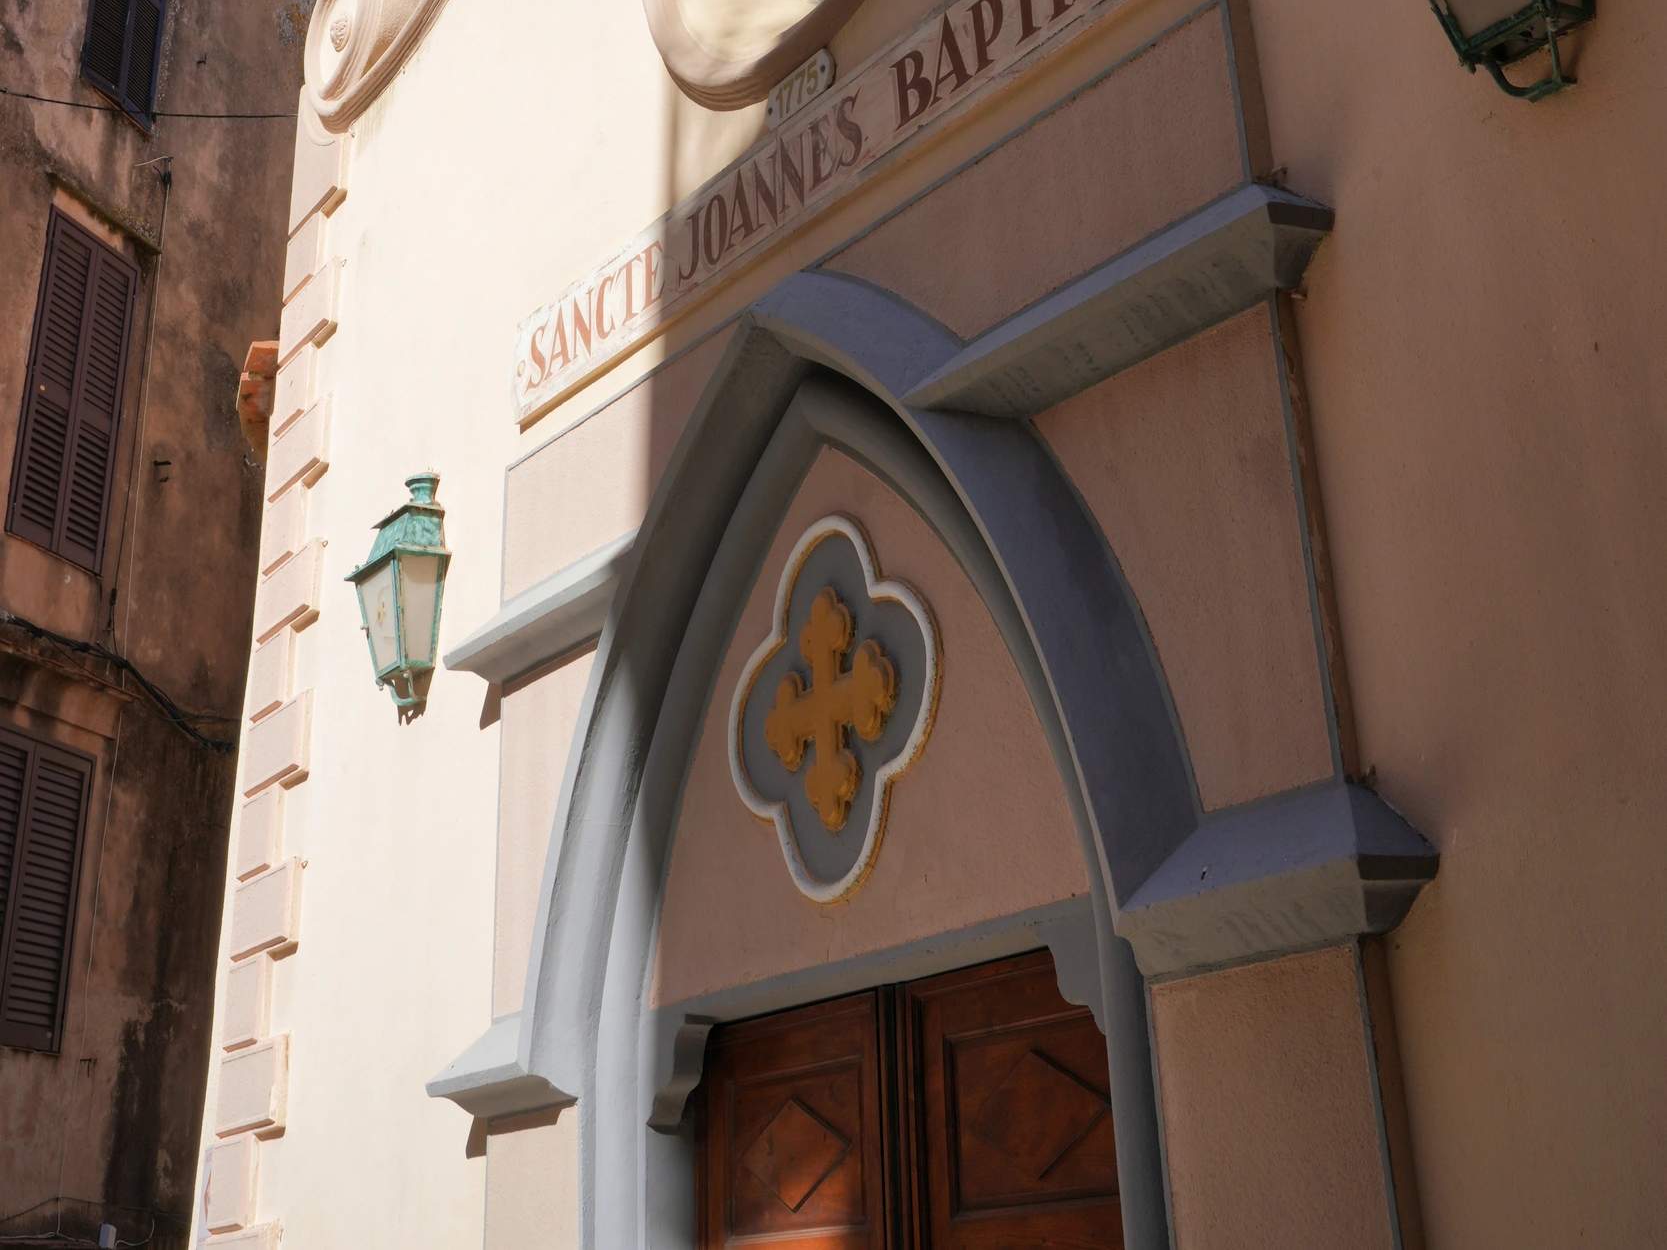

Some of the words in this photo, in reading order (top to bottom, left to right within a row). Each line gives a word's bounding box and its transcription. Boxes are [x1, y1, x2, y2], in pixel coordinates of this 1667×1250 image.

[775, 59, 818, 119] 1775
[524, 240, 665, 395] SANCTE
[678, 86, 863, 288] JOANNES
